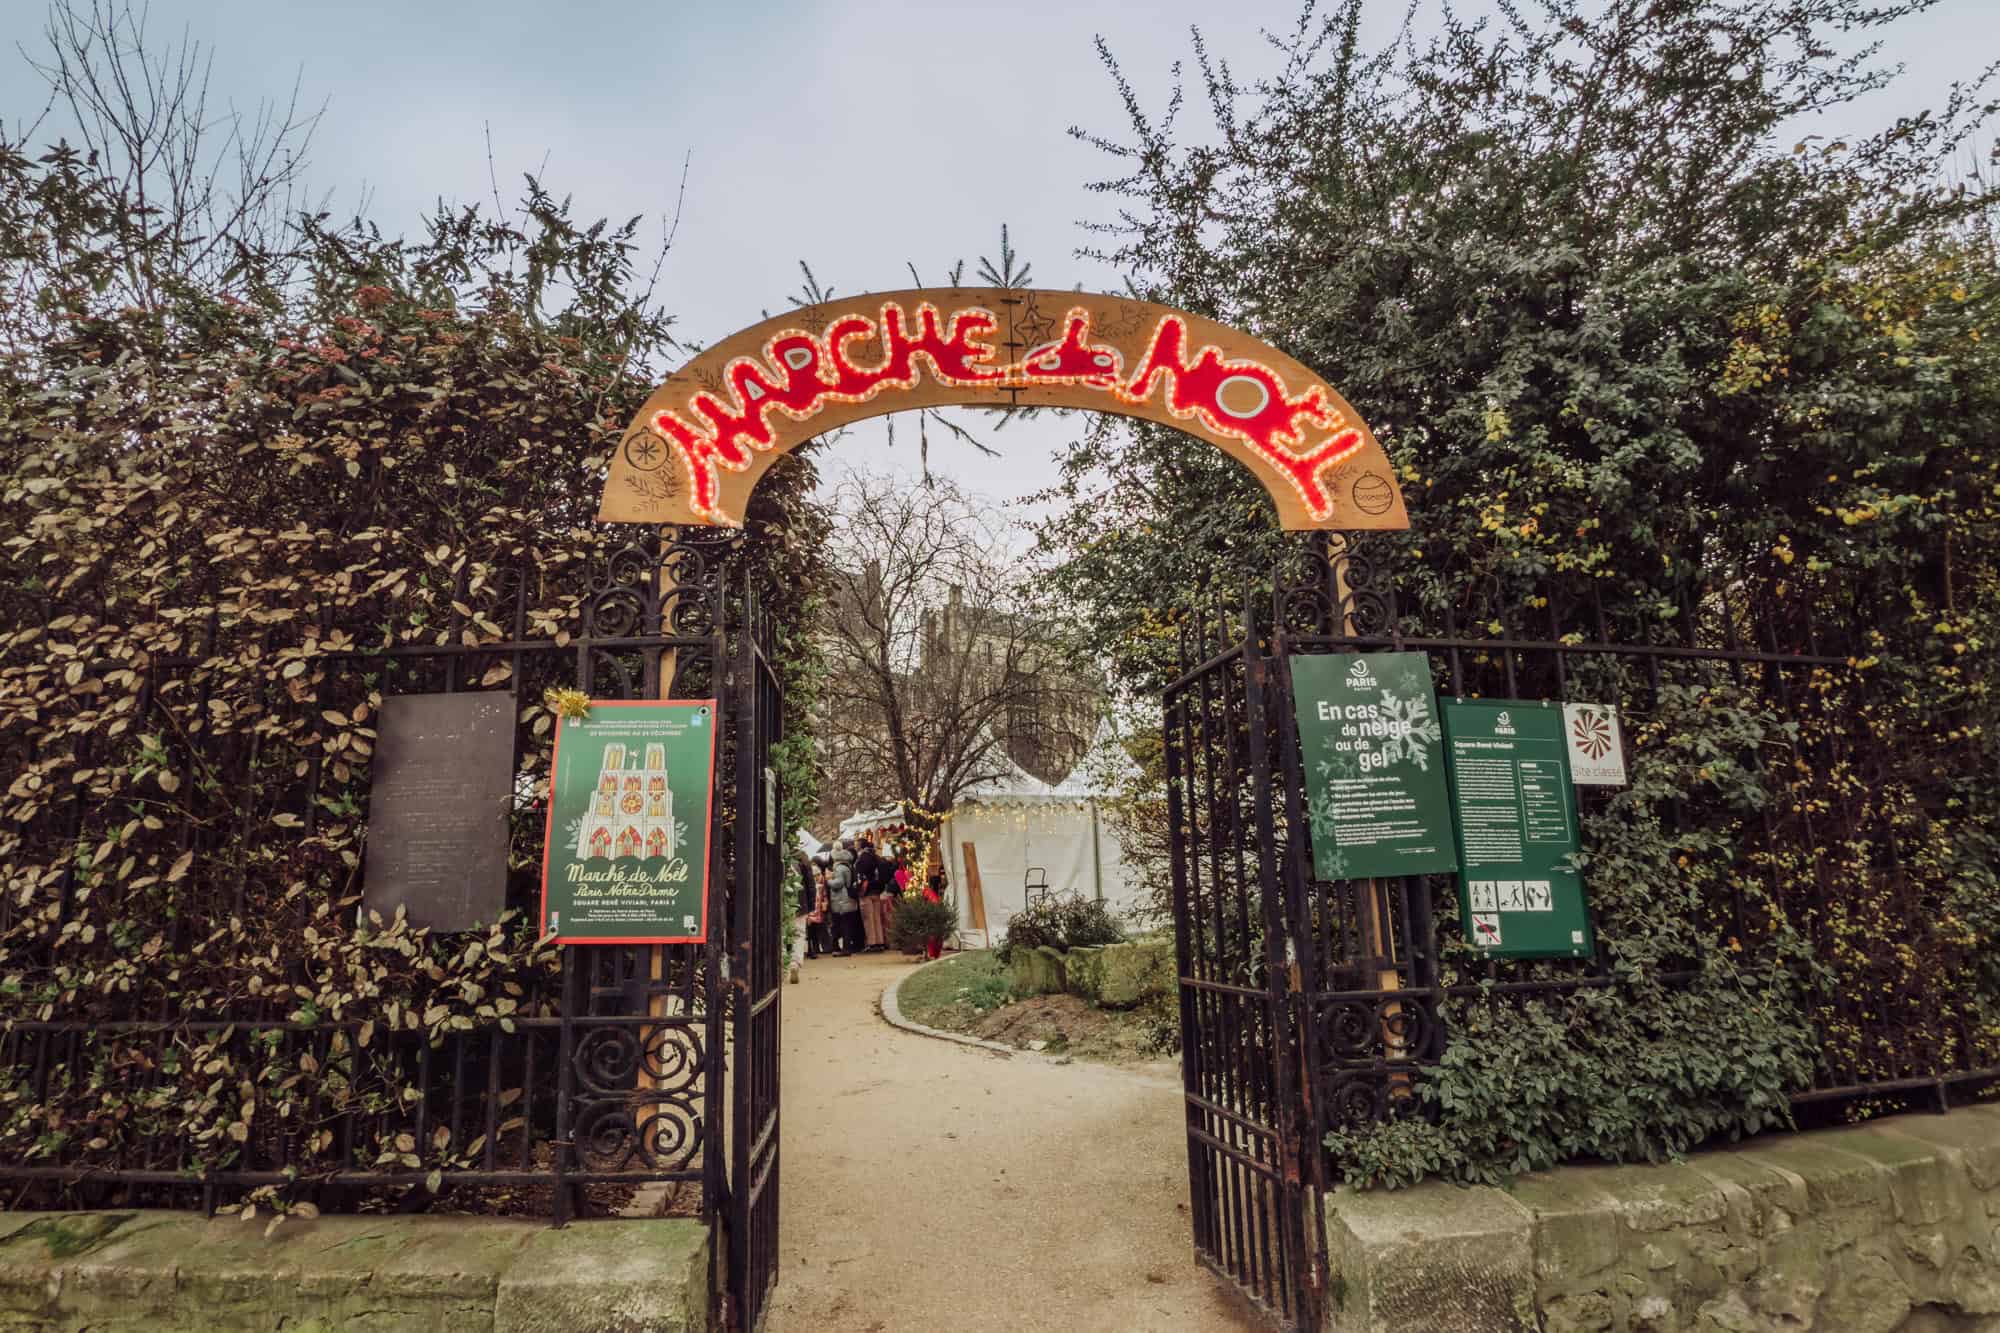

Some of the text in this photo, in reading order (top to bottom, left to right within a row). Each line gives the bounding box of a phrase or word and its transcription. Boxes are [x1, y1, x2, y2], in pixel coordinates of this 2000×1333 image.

[1345, 677, 1377, 688] PARIS
[1317, 700, 1379, 721] En cas
[1341, 718, 1412, 742] de neige
[1335, 738, 1370, 752] ou de
[1358, 745, 1389, 773] gel
[564, 857, 689, 883] Marché de Noël
[573, 883, 603, 897] Paris
[572, 899, 600, 907] SQUARE
[601, 898, 619, 907] RENÉ
